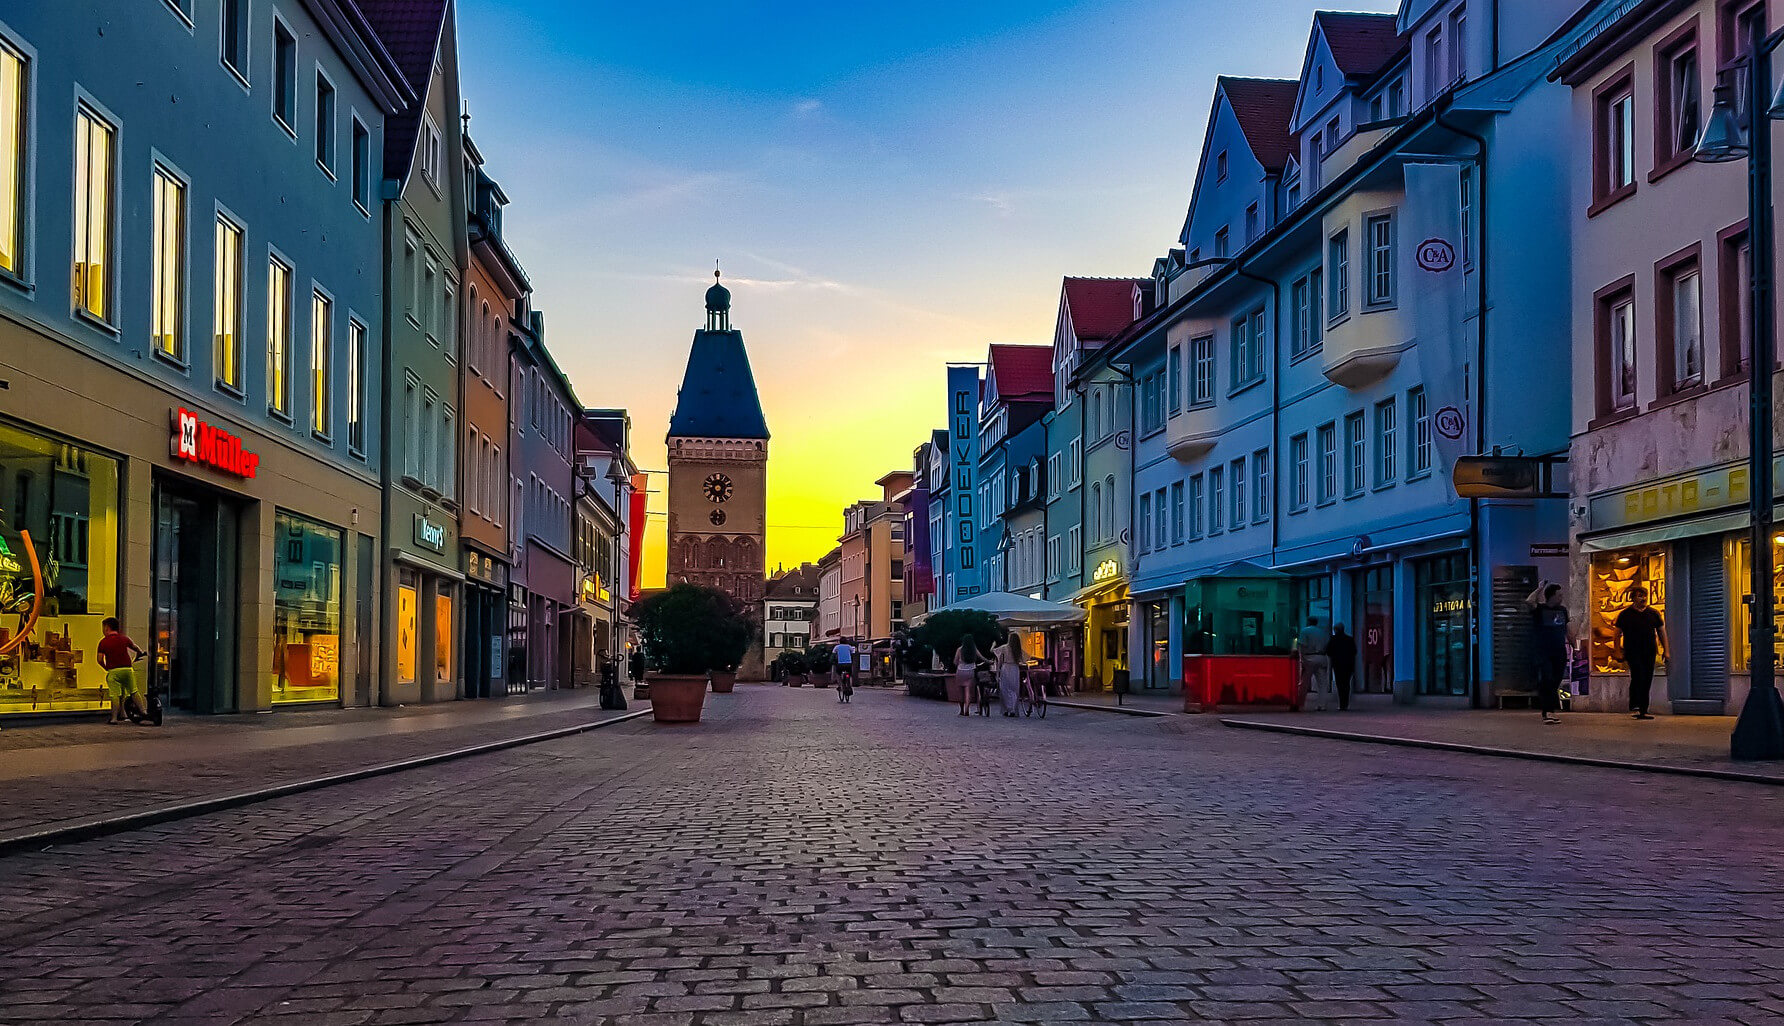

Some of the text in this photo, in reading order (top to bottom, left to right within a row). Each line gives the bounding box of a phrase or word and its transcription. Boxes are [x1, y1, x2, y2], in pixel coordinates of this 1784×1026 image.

[1423, 247, 1449, 264] C&A
[1440, 415, 1460, 431] C&A
[200, 420, 260, 479] Müller
[956, 390, 974, 570] BÖDEKER
[1625, 468, 1749, 519] FOTO-F
